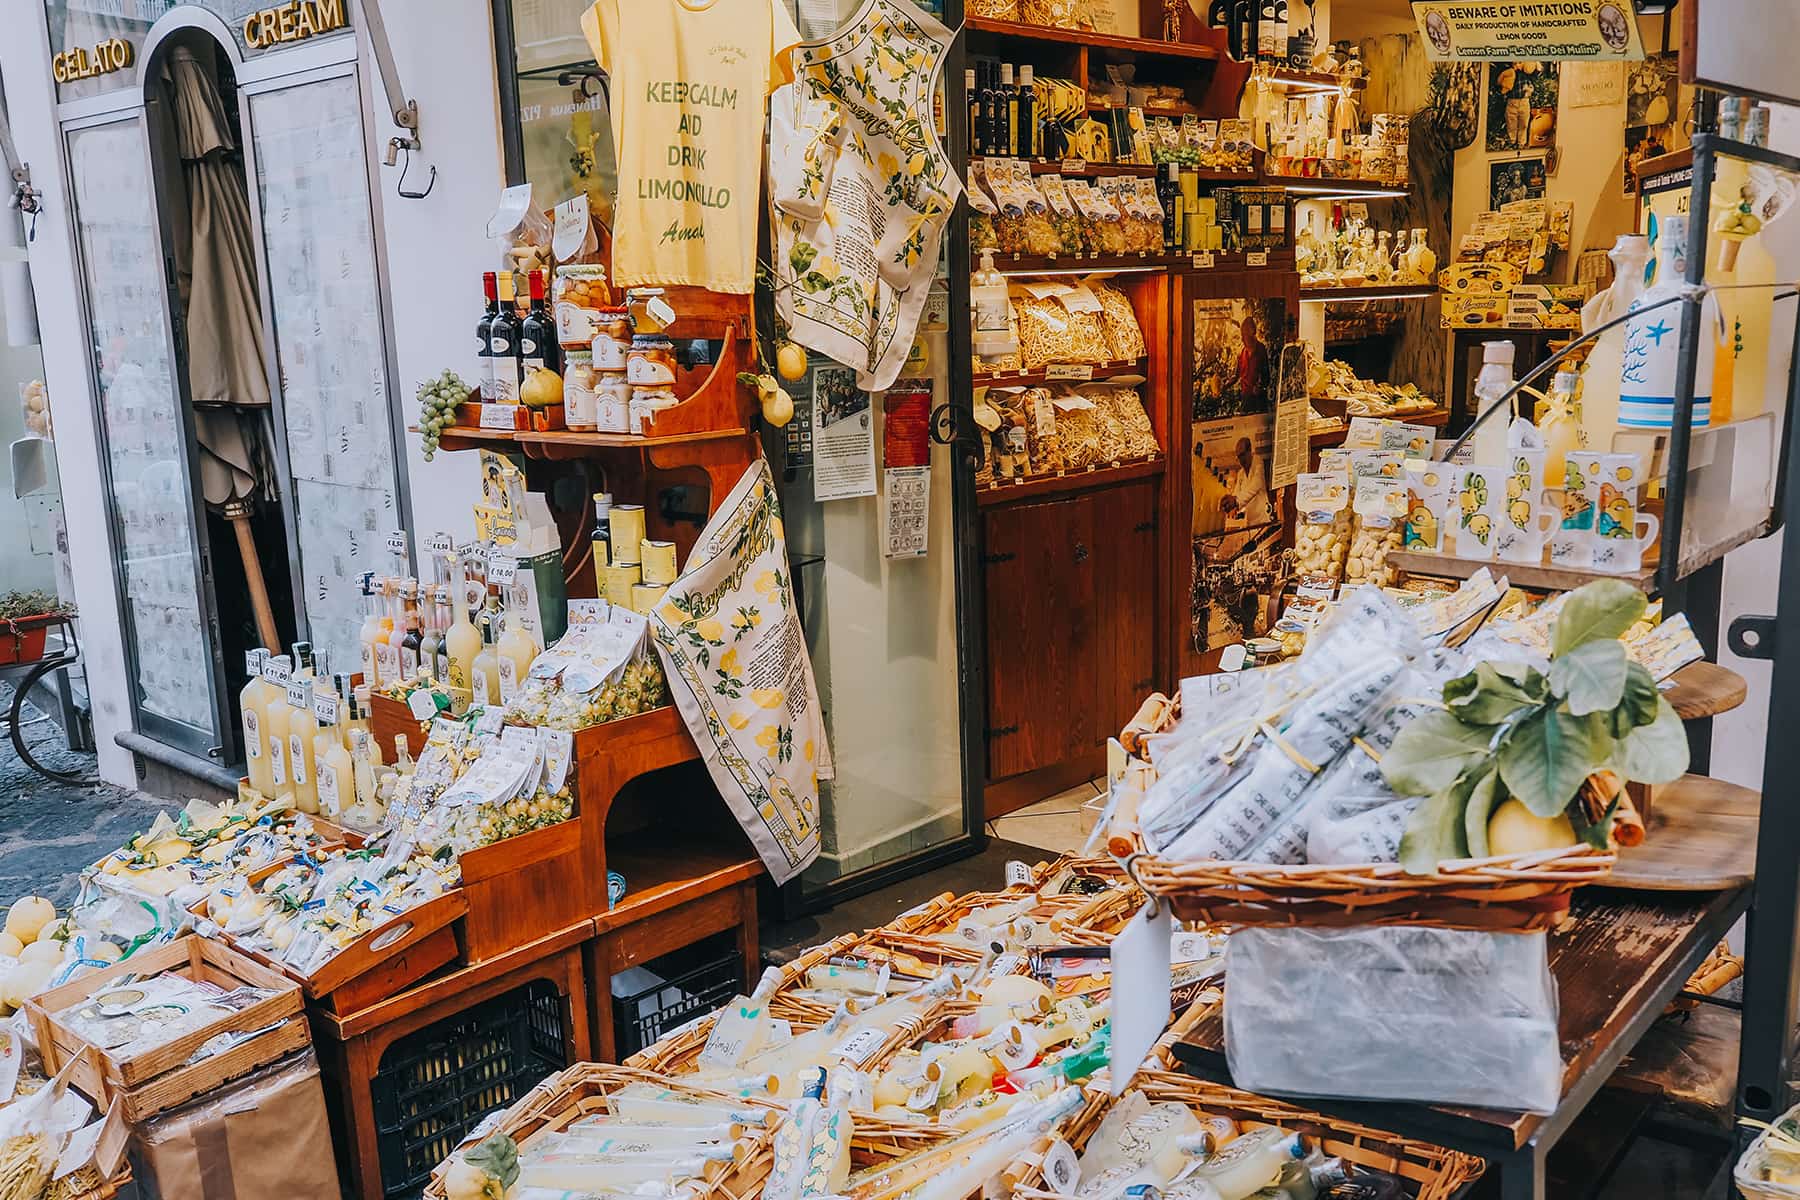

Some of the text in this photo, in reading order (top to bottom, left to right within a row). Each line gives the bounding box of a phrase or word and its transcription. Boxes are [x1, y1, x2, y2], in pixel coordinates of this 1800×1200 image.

[1449, 2, 1592, 19] BEWARE OF IMITATIONS
[244, 0, 345, 50] CREAM
[1532, 19, 1587, 28] HANDCRAFTED
[1521, 32, 1547, 40] GOODS
[1457, 45, 1482, 56] Lemon
[1484, 46, 1509, 56] Farm
[1526, 45, 1549, 55] Valle
[1550, 45, 1564, 55] Dei
[53, 38, 133, 83] GELATO
[689, 84, 737, 110] CALM
